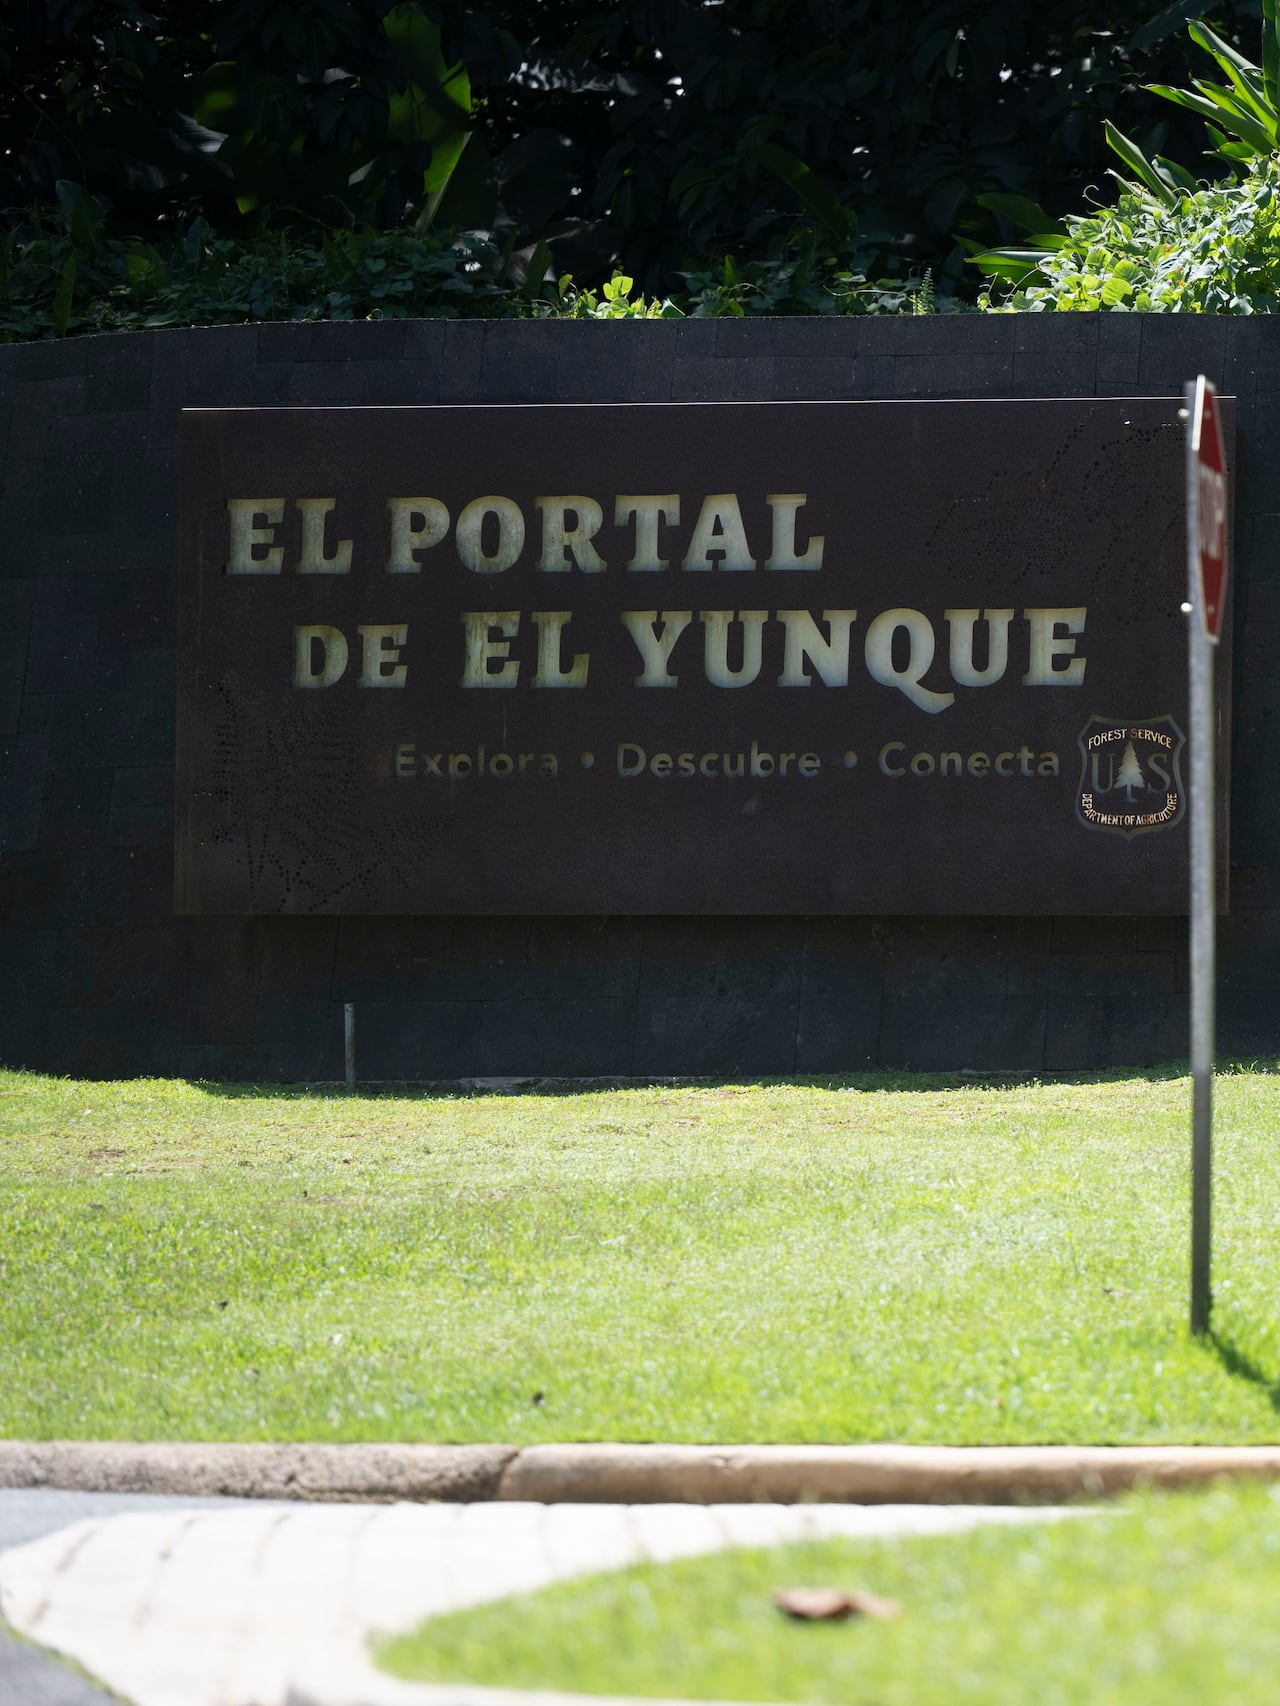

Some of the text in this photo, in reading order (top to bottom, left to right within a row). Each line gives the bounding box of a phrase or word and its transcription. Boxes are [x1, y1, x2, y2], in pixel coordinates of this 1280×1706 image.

[225, 493, 826, 575] EL PORTAL
[292, 606, 1088, 715] DE EL YUNQUE
[1088, 727, 1172, 750] FOREST SERVICE
[393, 740, 1060, 782] Explora Descubre Conecta
[1081, 792, 1178, 826] DEPARTMENT OF AGRICULTURE
